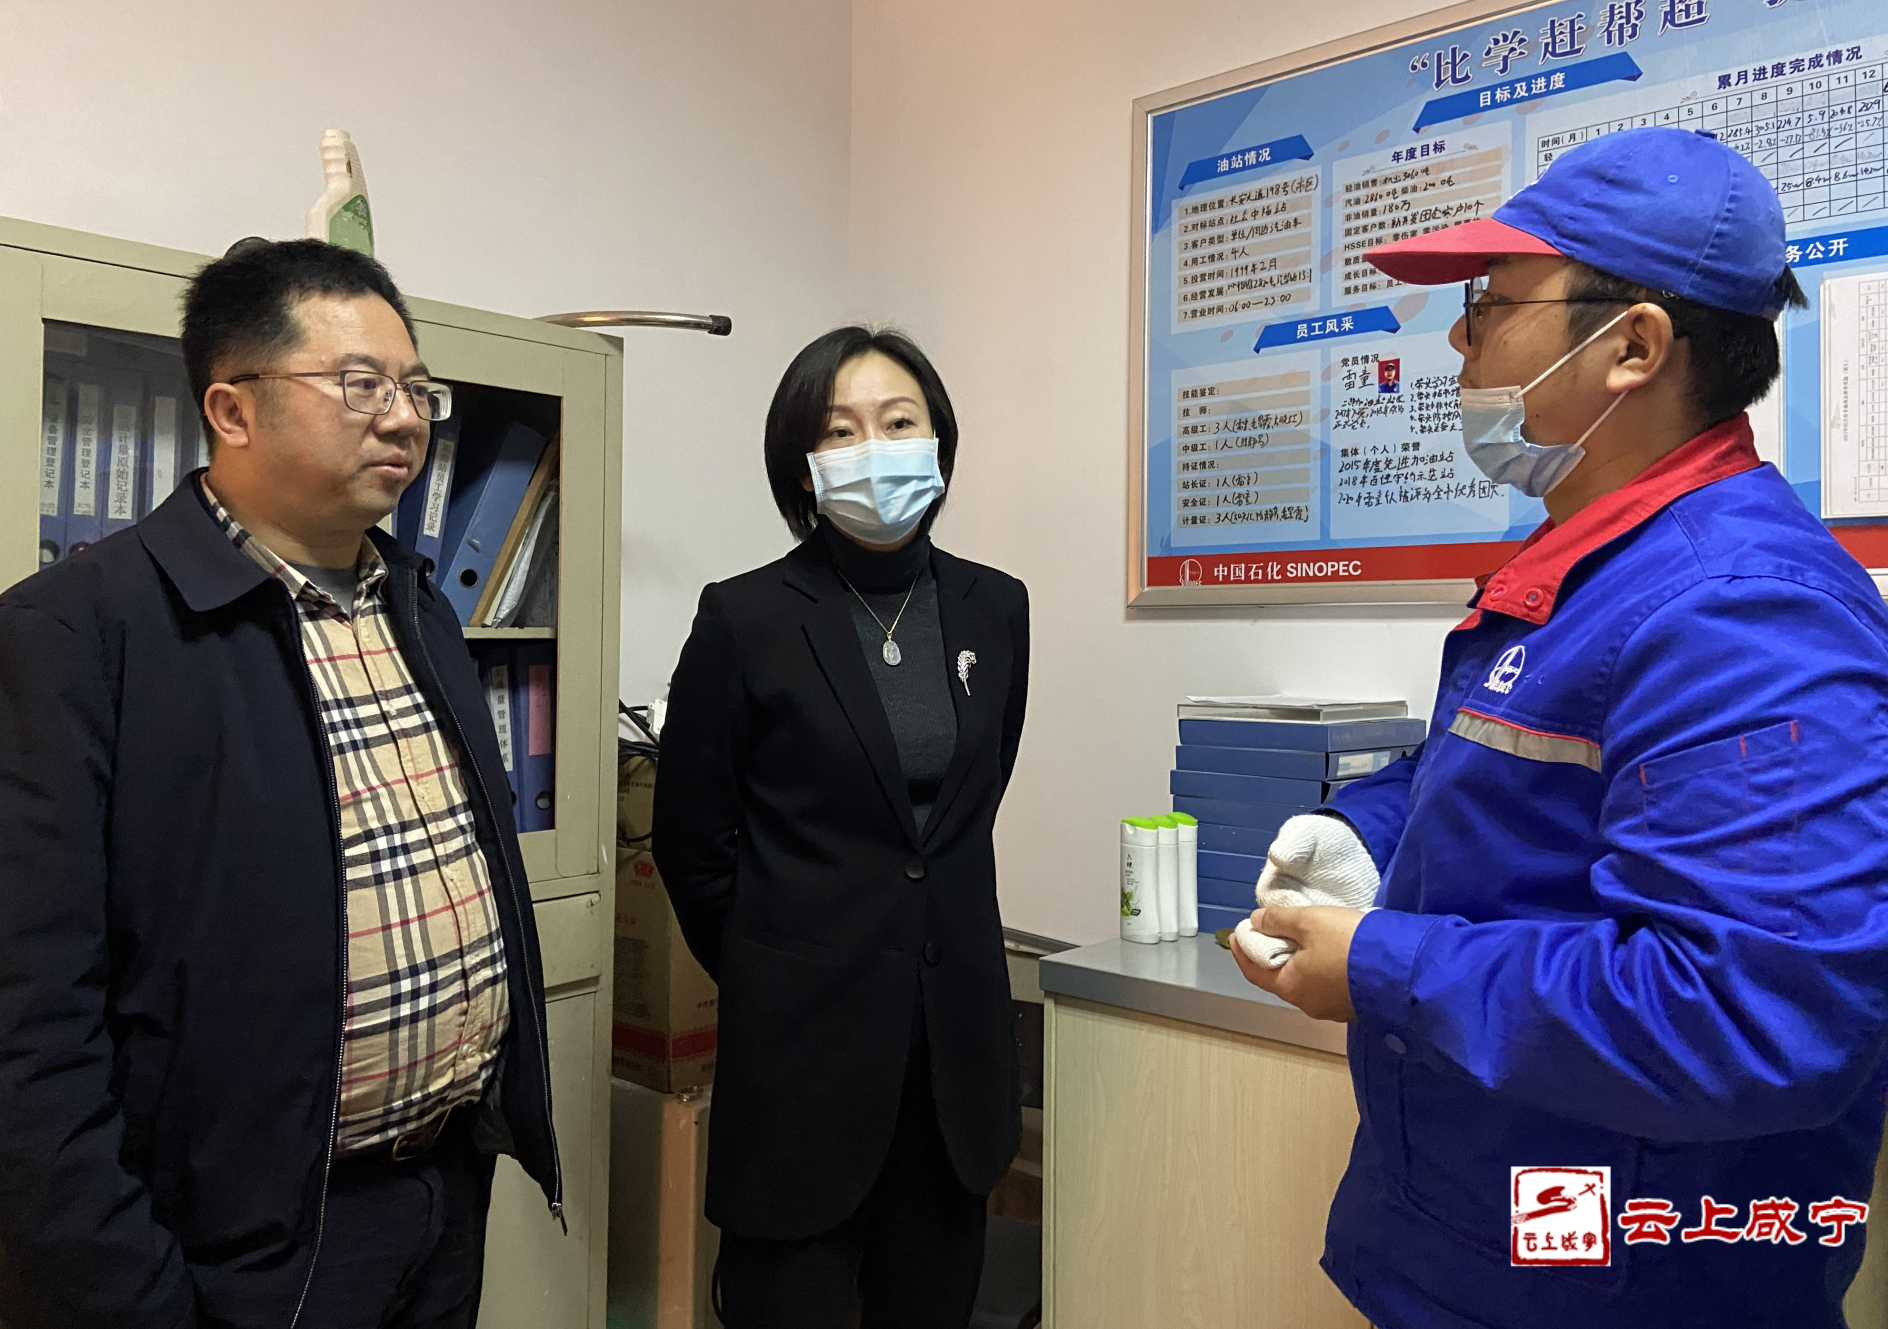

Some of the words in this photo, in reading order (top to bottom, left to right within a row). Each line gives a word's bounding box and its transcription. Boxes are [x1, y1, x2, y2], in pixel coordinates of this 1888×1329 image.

[1717, 46, 1863, 90] 累月进度完成情况
[1862, 70, 1876, 79] 12
[1835, 75, 1849, 84] 11
[1478, 71, 1567, 108] 目标及进度
[1809, 81, 1822, 90] 10
[1786, 87, 1793, 95] 9
[1761, 92, 1768, 100] 8
[1736, 98, 1743, 106] 7
[1711, 103, 1718, 111] 6
[1687, 108, 1693, 116] 5
[1663, 113, 1670, 121] 4
[1640, 118, 1647, 126] 3
[1595, 128, 1600, 136] 1
[1618, 123, 1624, 132] 2
[1391, 140, 1446, 164] 年度目标
[1217, 148, 1271, 172] 油站情况
[1296, 316, 1355, 338] 员工风采
[1341, 353, 1380, 368] 党员情况
[1214, 561, 1282, 582] 中国石化
[1286, 560, 1362, 577] SINOPEC
